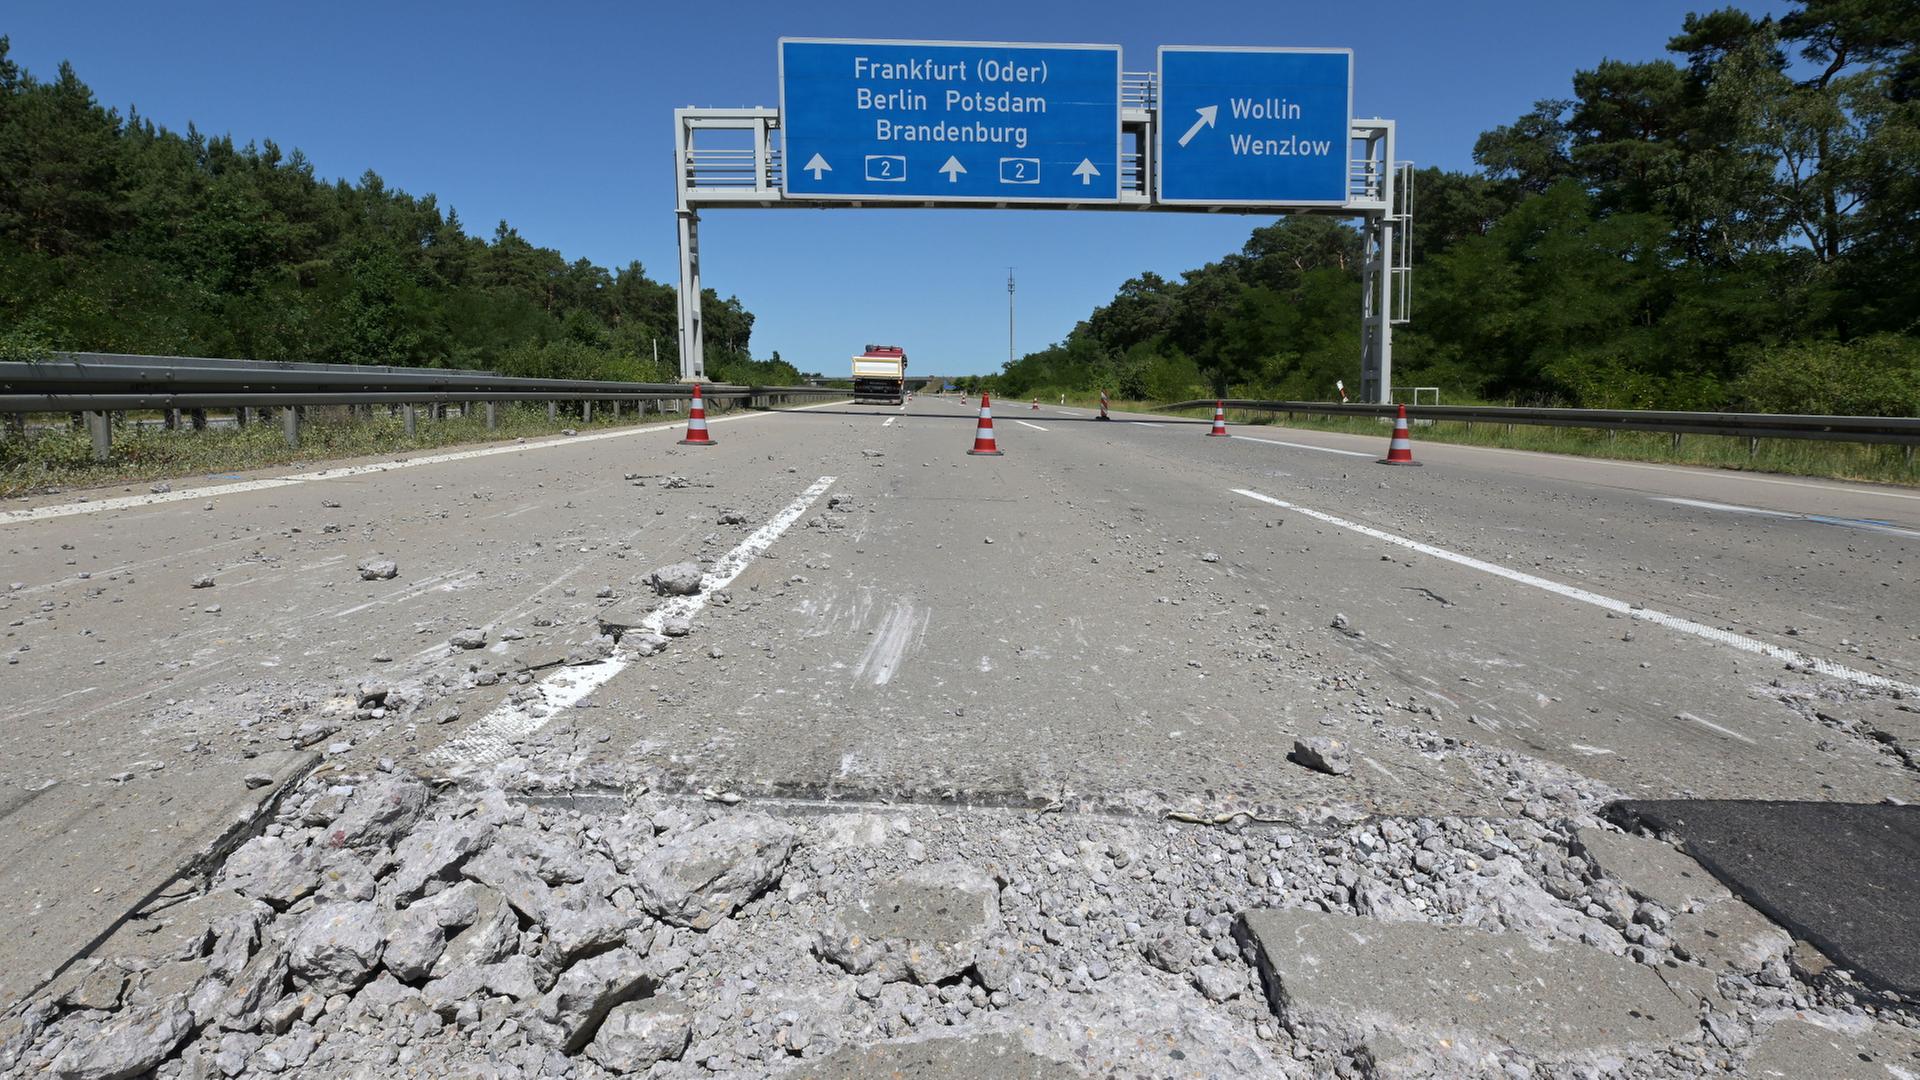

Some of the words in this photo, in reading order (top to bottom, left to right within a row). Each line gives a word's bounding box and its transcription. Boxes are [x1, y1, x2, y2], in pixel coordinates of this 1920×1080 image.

[855, 57, 967, 81] Frankfurt
[977, 59, 1048, 84] (Oder)
[857, 88, 927, 111] Berlin
[946, 90, 1046, 113] Potsdam
[1230, 98, 1301, 120] Wollin
[876, 119, 1028, 148] Brandenburg
[1230, 134, 1331, 156] Wenzlow
[880, 160, 891, 176] 2
[1014, 163, 1026, 179] 2
